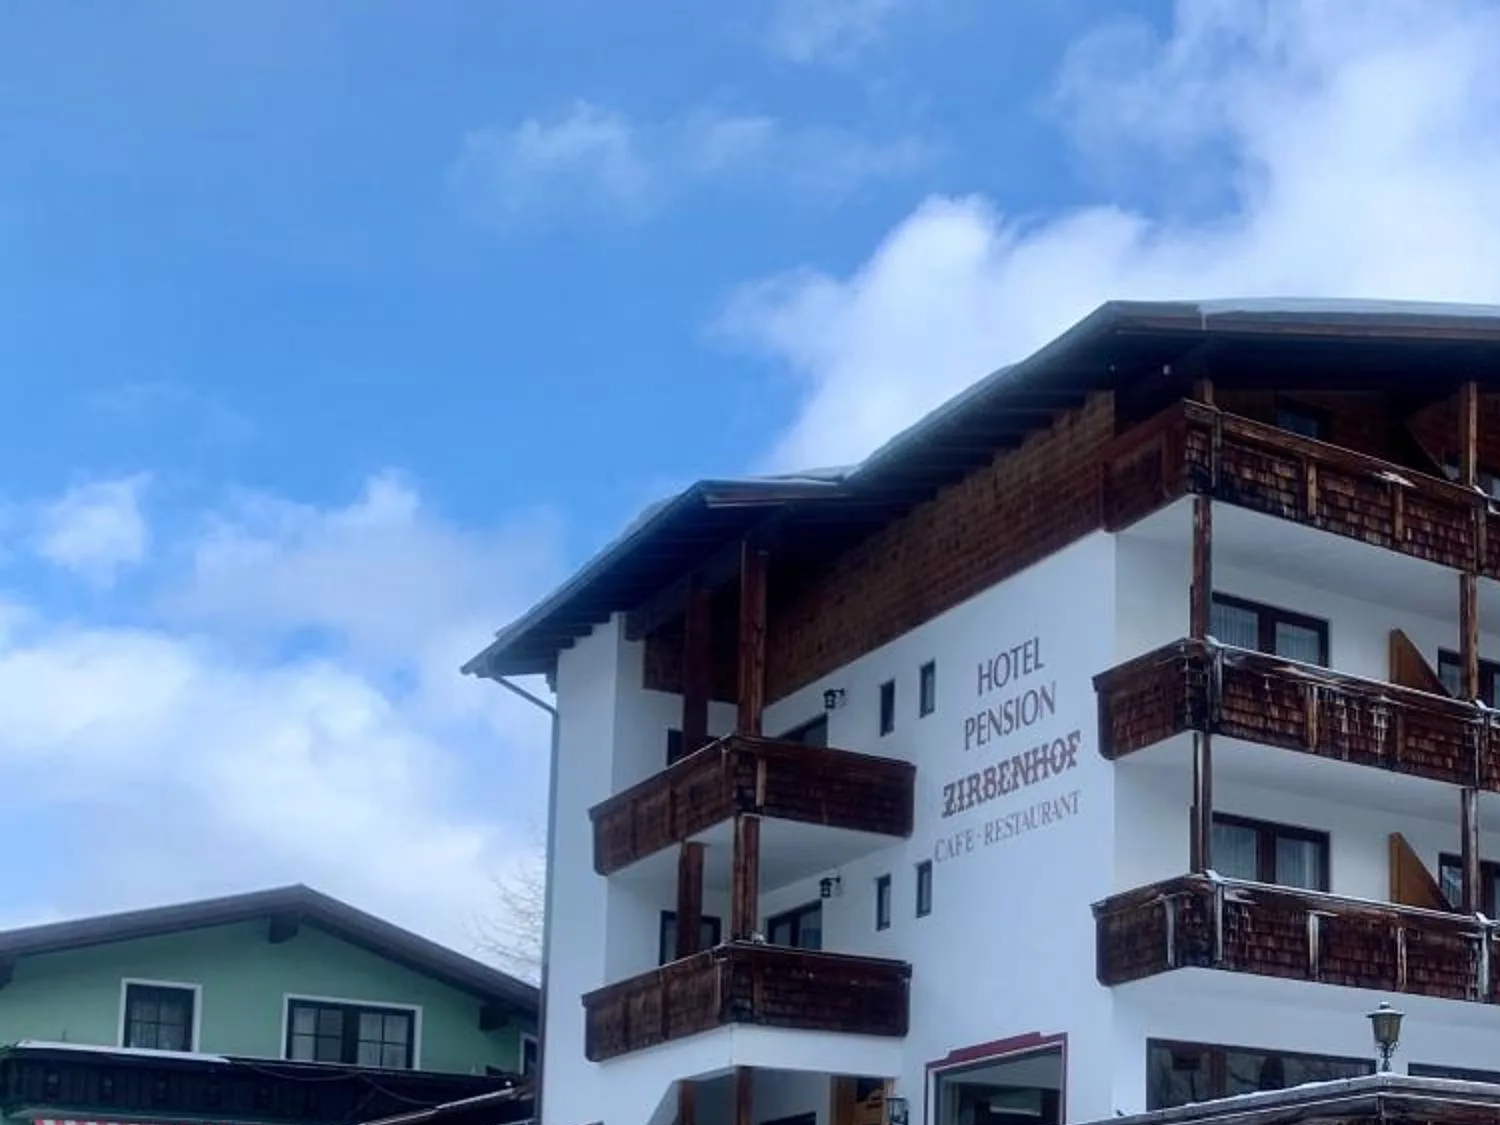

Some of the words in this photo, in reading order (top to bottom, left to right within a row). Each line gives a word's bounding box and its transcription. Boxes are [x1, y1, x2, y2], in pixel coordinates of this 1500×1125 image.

[977, 636, 1045, 697] HOTEL
[963, 680, 1057, 752] PENSION
[941, 728, 1082, 819] ZIRBENHOF
